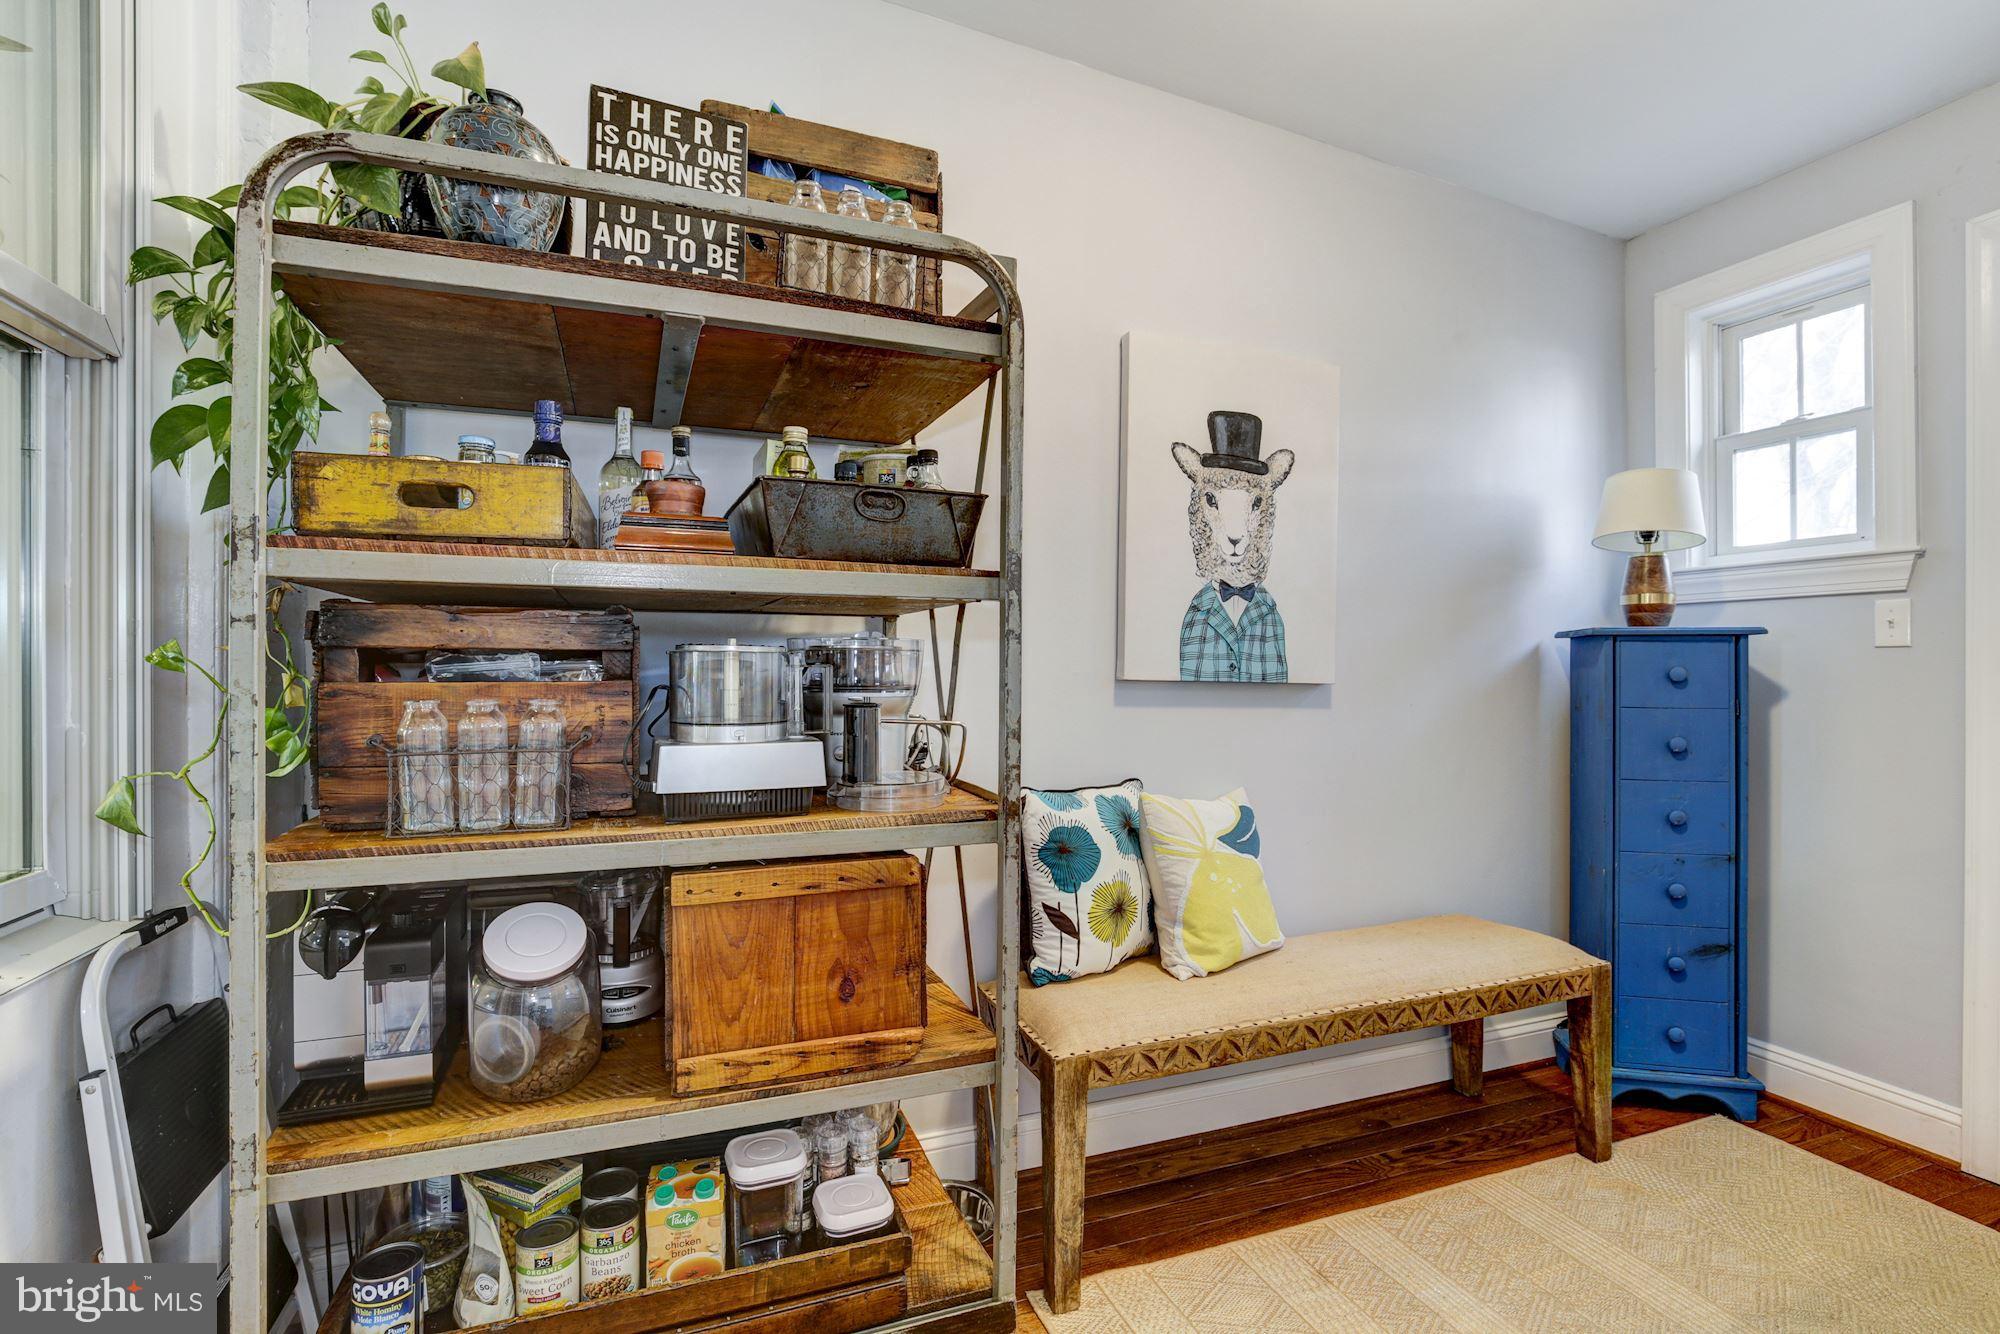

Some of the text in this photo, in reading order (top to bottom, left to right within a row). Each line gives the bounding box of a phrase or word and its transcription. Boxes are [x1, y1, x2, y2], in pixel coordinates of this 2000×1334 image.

[597, 91, 744, 154] THERE
[596, 122, 742, 175] IS ONLY ONE
[595, 143, 742, 197] HAPPINESS
[593, 221, 651, 254] AND
[662, 234, 697, 263] TO
[706, 243, 740, 273] BE
[605, 1004, 637, 1014] Cuisinart
[668, 1213, 696, 1226] Pacific
[589, 1244, 624, 1254] ORGANIC
[598, 1238, 612, 1247] 365
[665, 1238, 702, 1251] chicken
[584, 1251, 630, 1267] Garbanzo
[671, 1247, 696, 1258] broth
[536, 1258, 550, 1268] 365
[526, 1264, 562, 1276] ORGANIC
[591, 1265, 622, 1276] Beans
[352, 1276, 409, 1302] GOYA
[548, 1276, 573, 1293] Corn
[355, 1302, 403, 1316] White Hominy
[373, 1312, 400, 1323] Blanco
